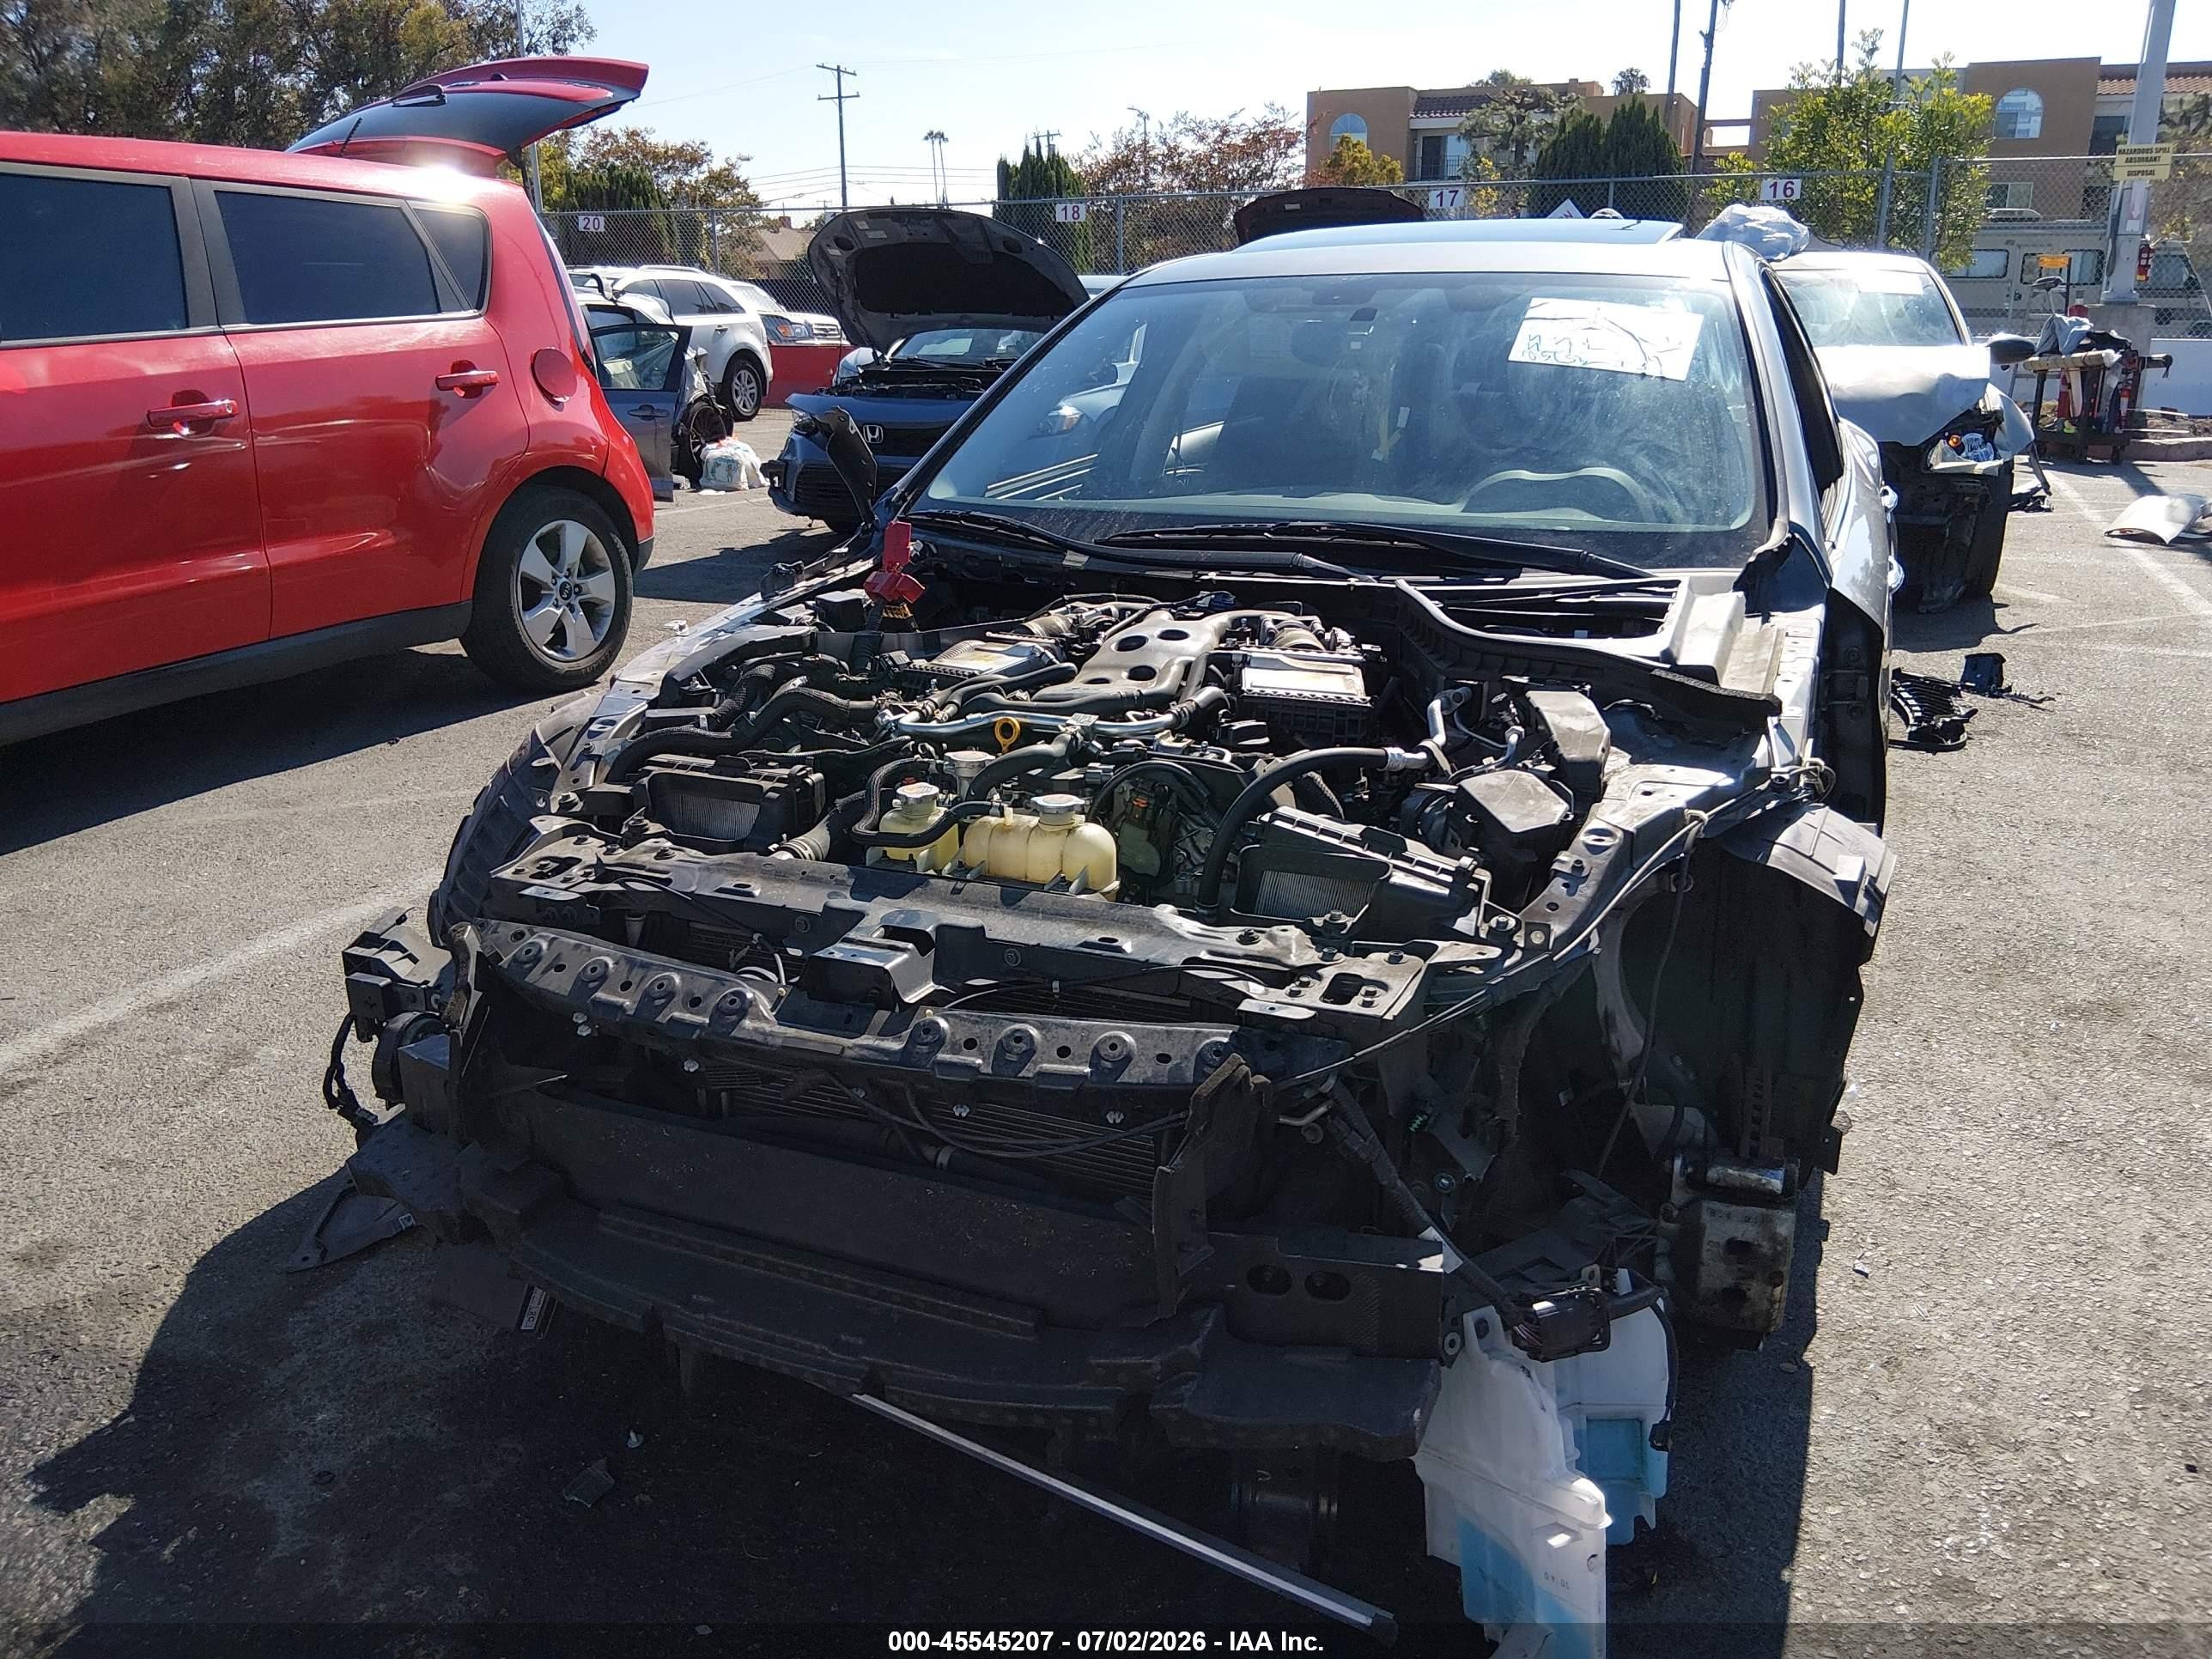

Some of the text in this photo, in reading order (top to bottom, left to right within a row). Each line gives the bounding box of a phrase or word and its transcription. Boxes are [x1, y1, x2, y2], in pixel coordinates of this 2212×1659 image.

[1436, 189, 1459, 207] 17
[1769, 180, 1795, 199] 16
[1060, 204, 1080, 221] 18
[583, 216, 600, 231] 20
